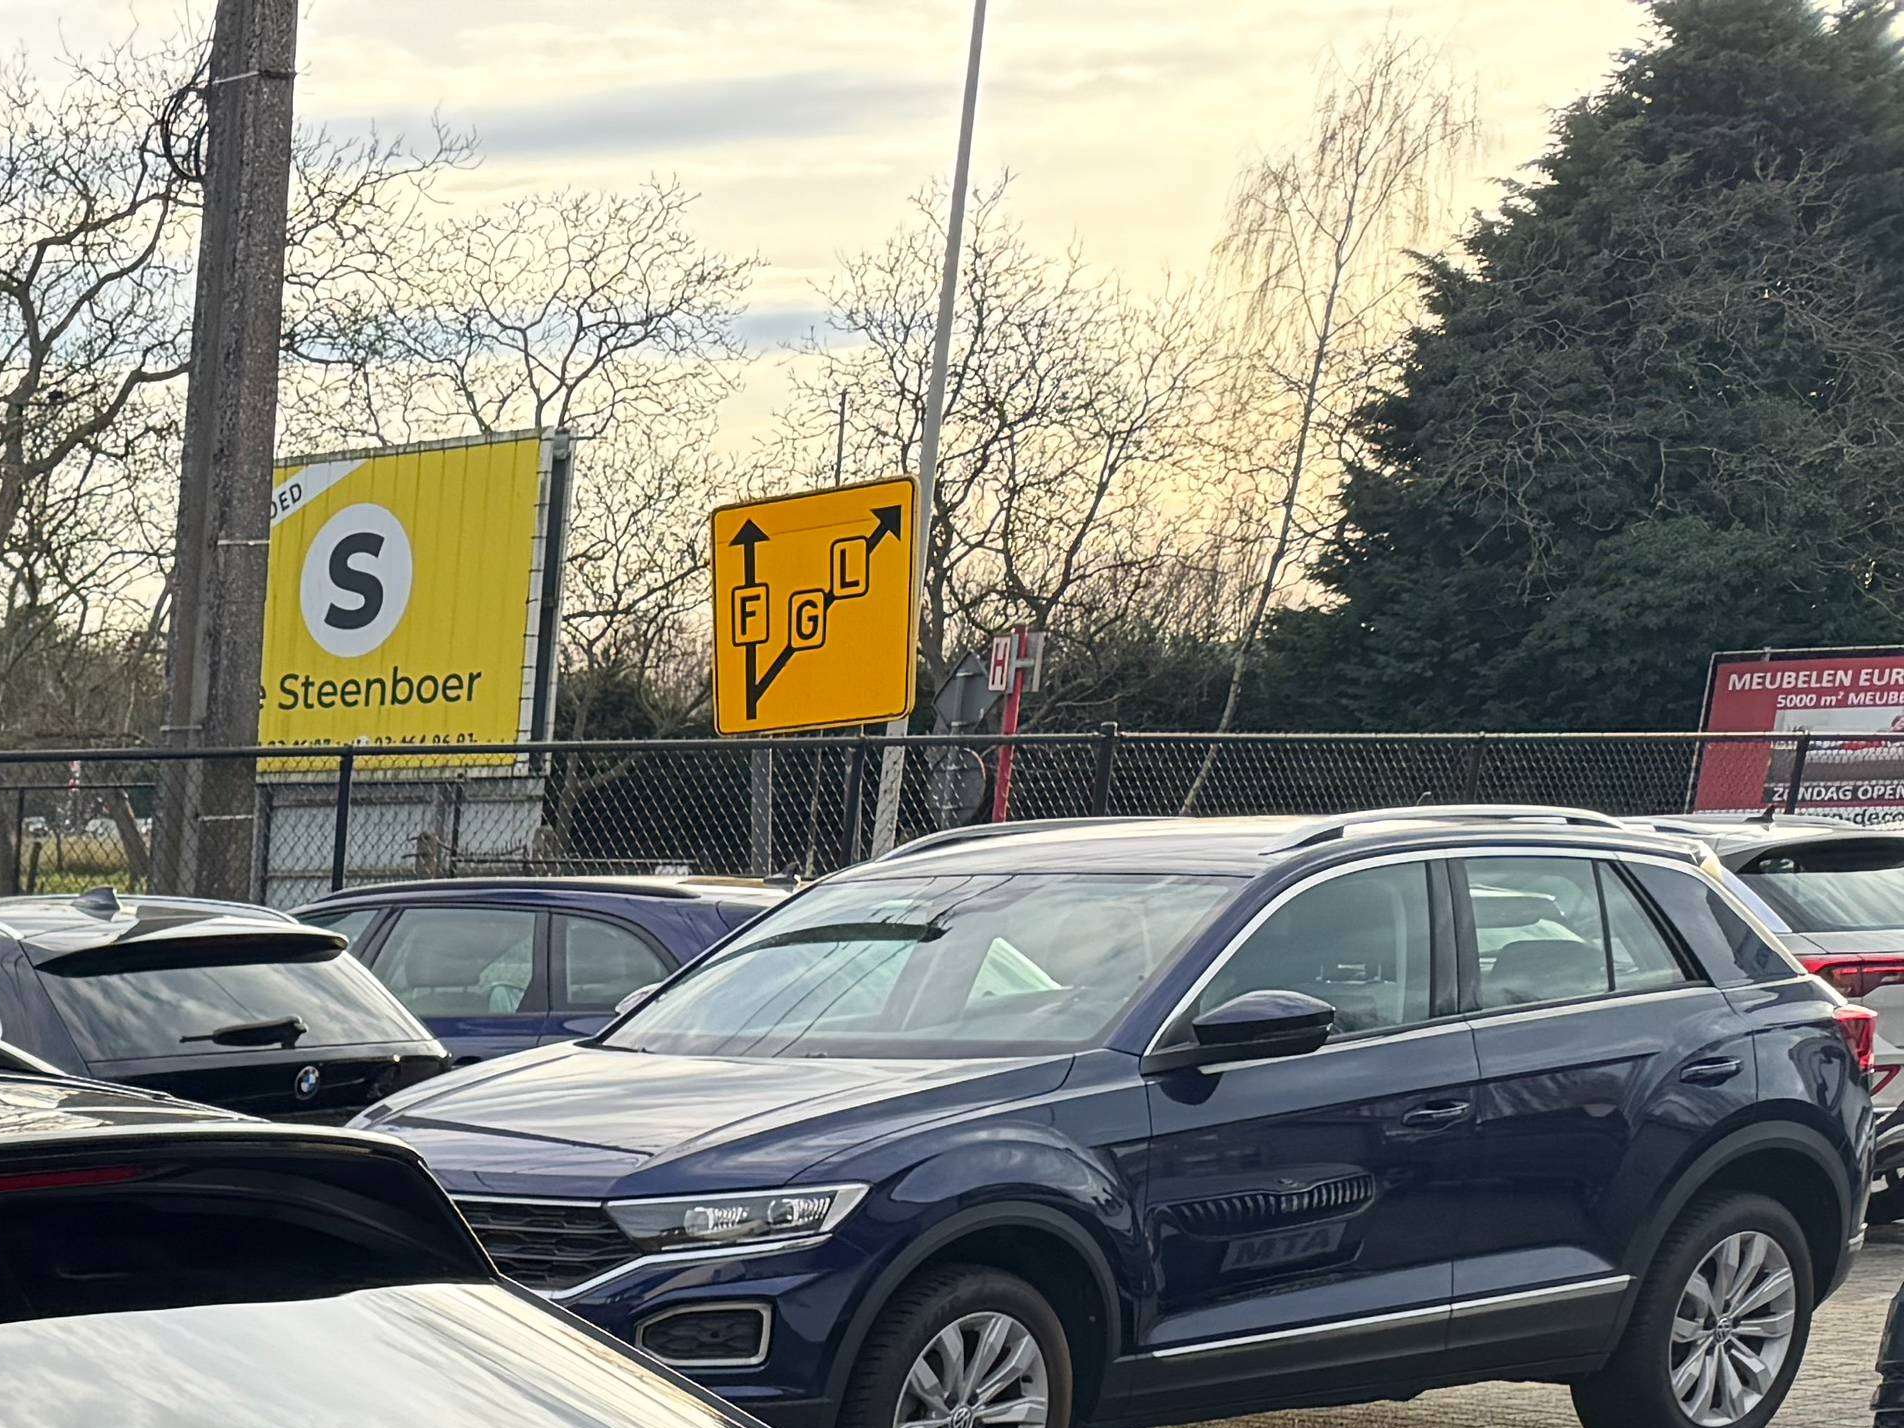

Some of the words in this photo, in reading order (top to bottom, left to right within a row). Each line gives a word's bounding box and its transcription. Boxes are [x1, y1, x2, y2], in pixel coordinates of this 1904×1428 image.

[324, 532, 385, 630] S
[840, 548, 860, 590] L
[740, 594, 761, 636] F
[795, 599, 819, 640] G
[278, 665, 482, 710] Steenboer
[1728, 669, 1853, 691] MEUBELEN
[1776, 693, 1817, 708] 5000
